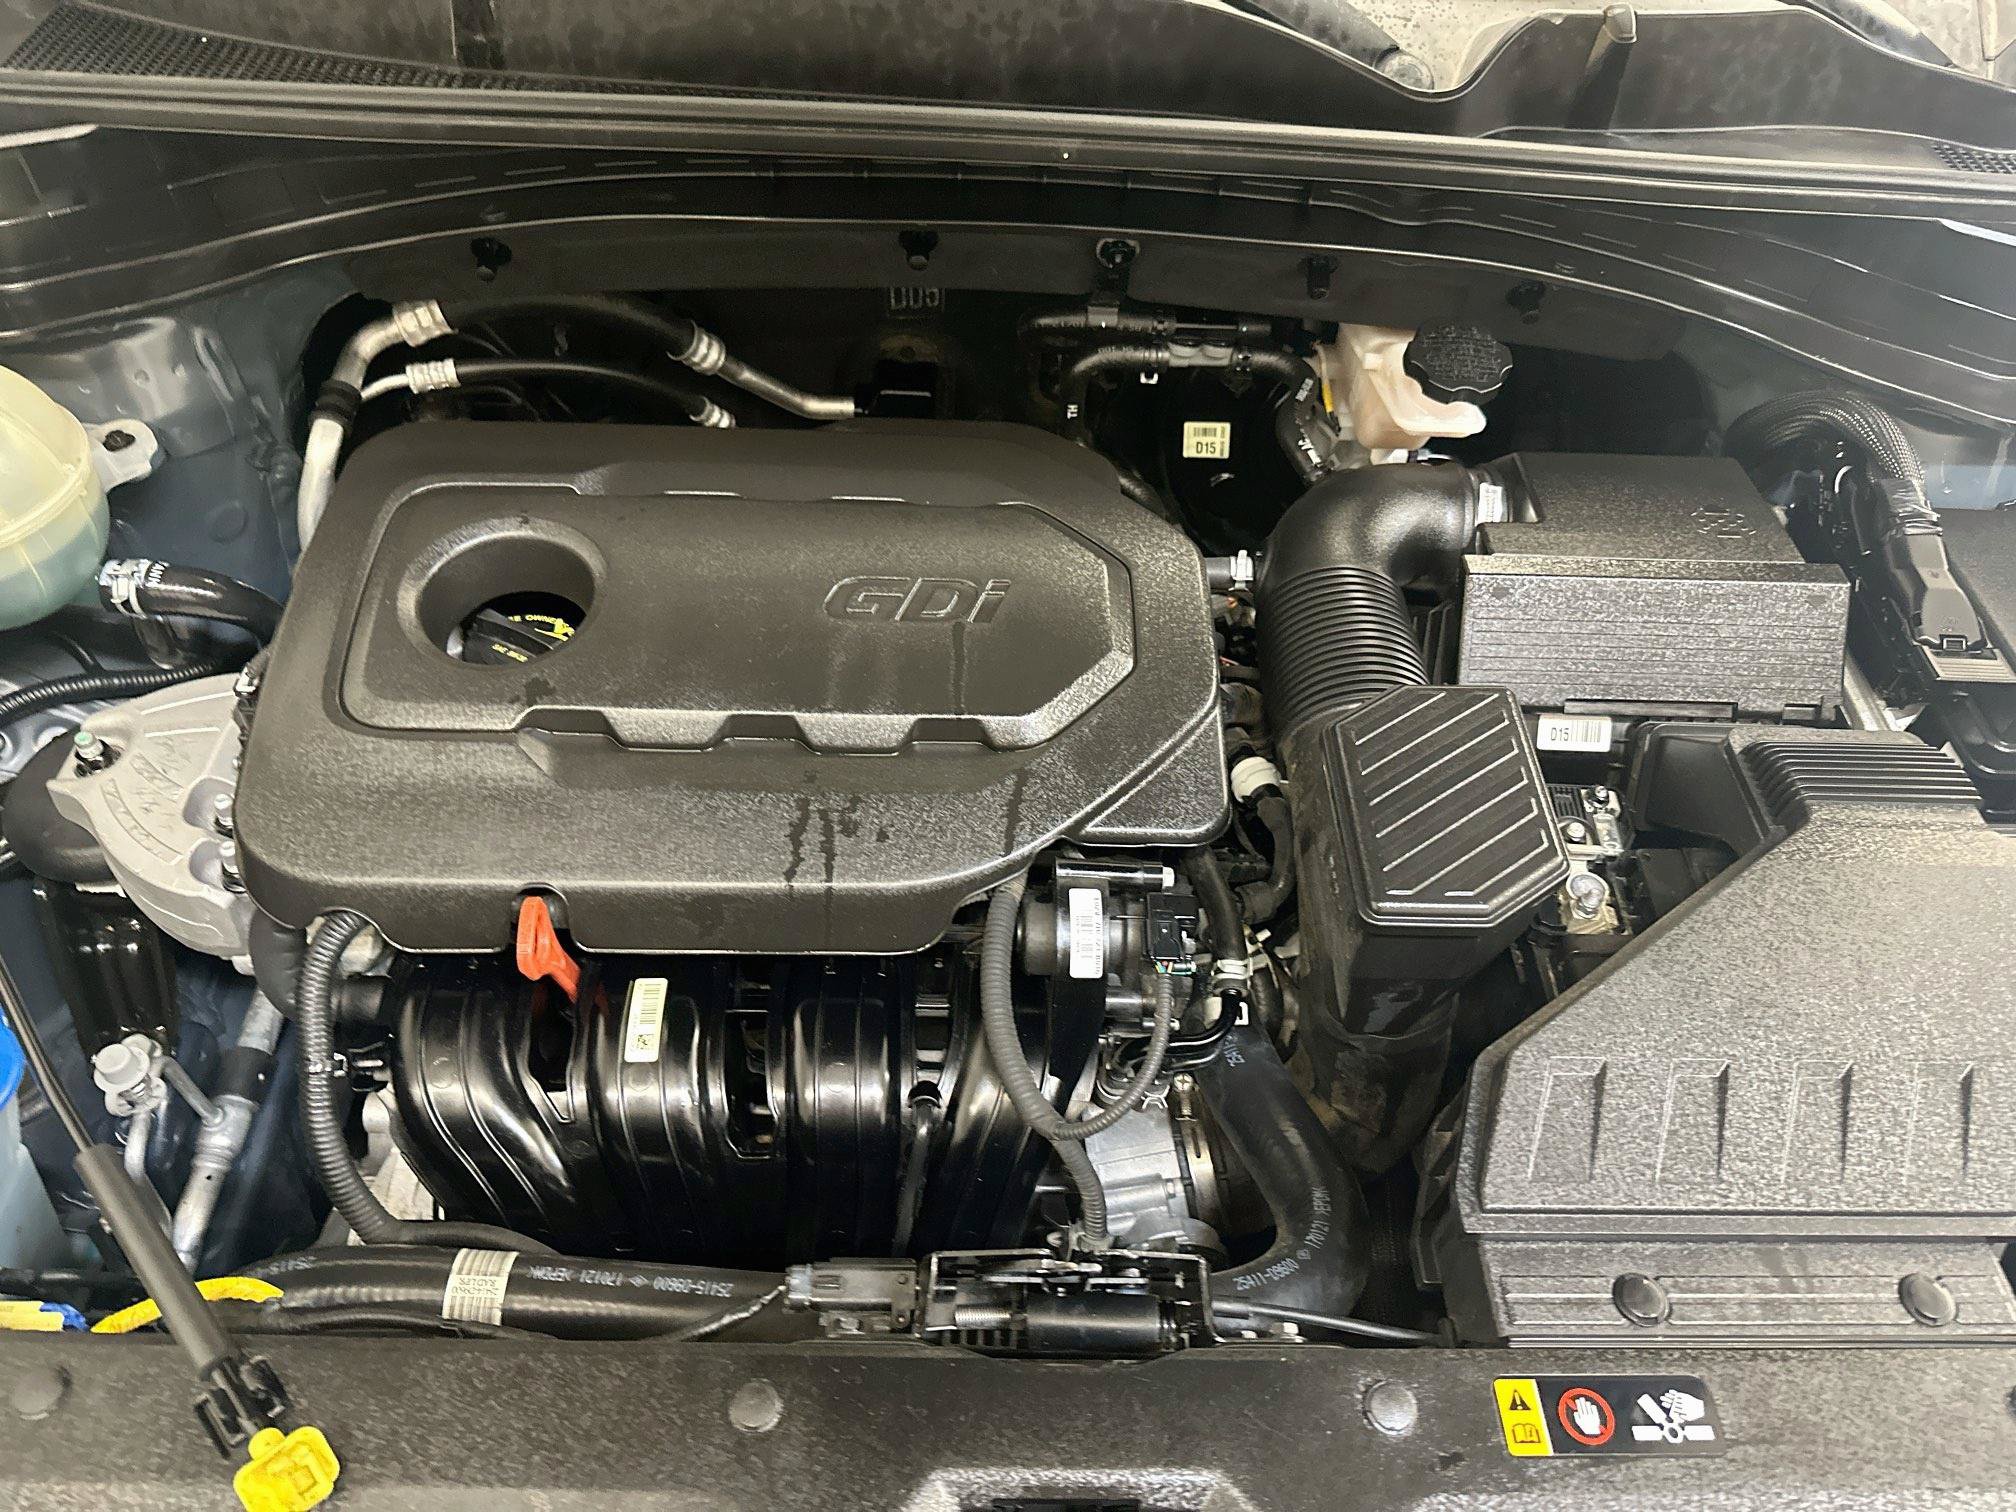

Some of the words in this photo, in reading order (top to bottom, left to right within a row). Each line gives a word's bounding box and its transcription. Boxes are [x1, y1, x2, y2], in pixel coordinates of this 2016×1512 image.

[1195, 441, 1217, 455] D15
[822, 574, 1012, 625] GDi
[1550, 727, 1570, 742] D15
